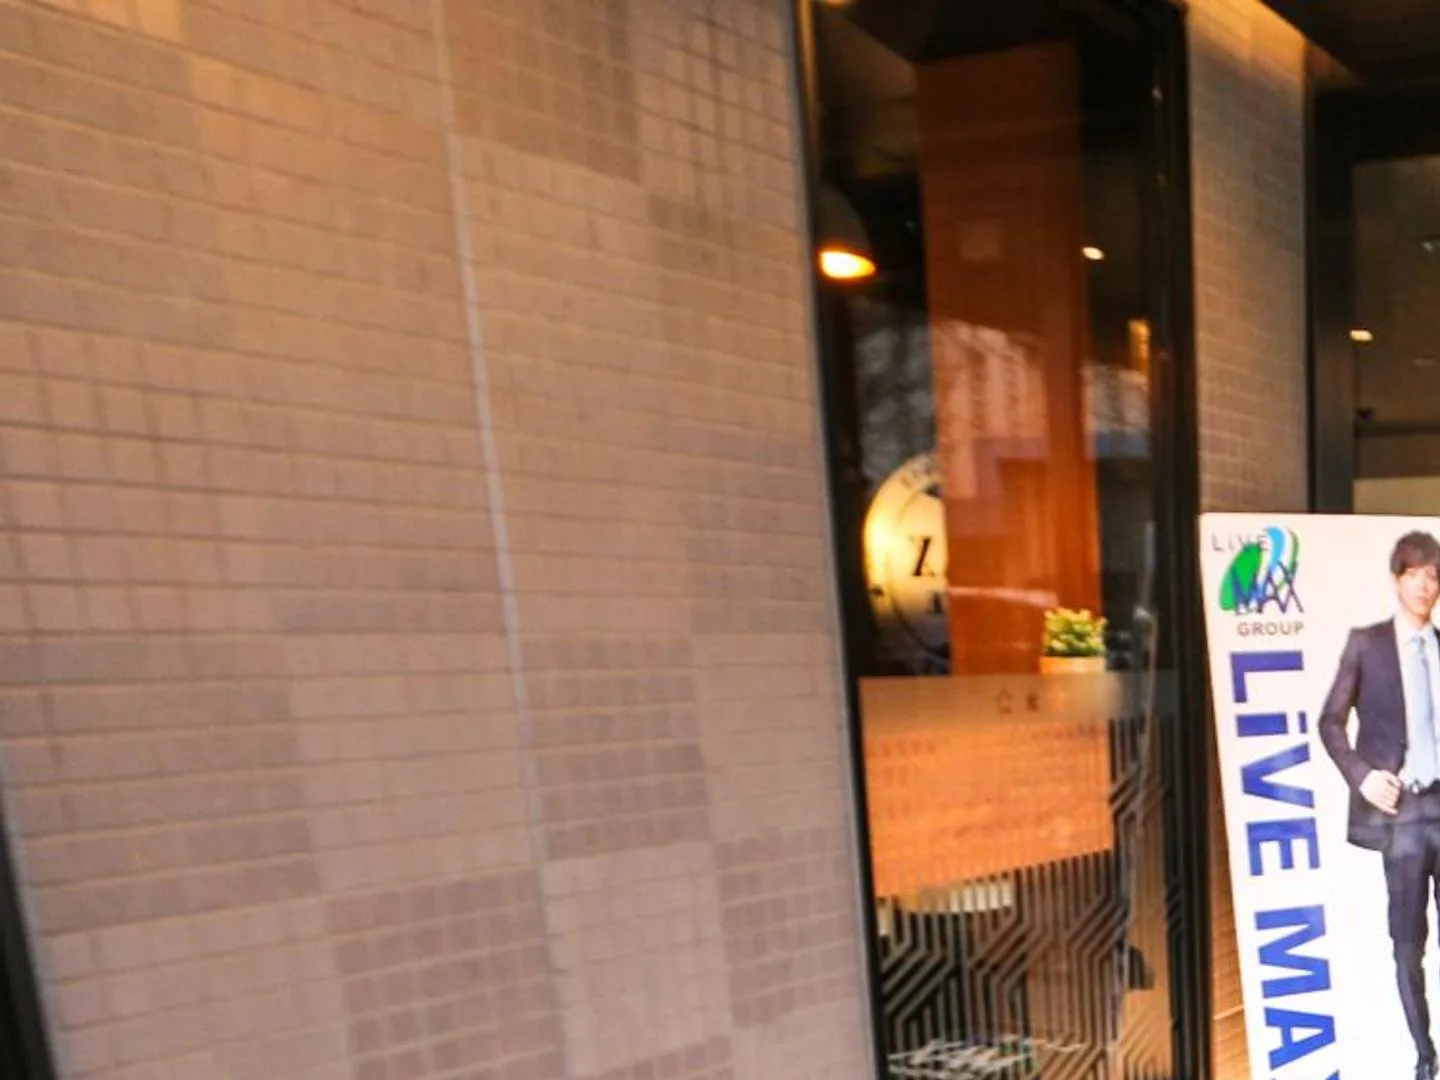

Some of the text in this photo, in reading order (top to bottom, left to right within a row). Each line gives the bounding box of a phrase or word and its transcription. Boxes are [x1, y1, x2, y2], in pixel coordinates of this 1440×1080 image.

[1231, 560, 1305, 616] MAX
[1237, 620, 1305, 637] GROUP
[1228, 649, 1322, 877] LiVE
